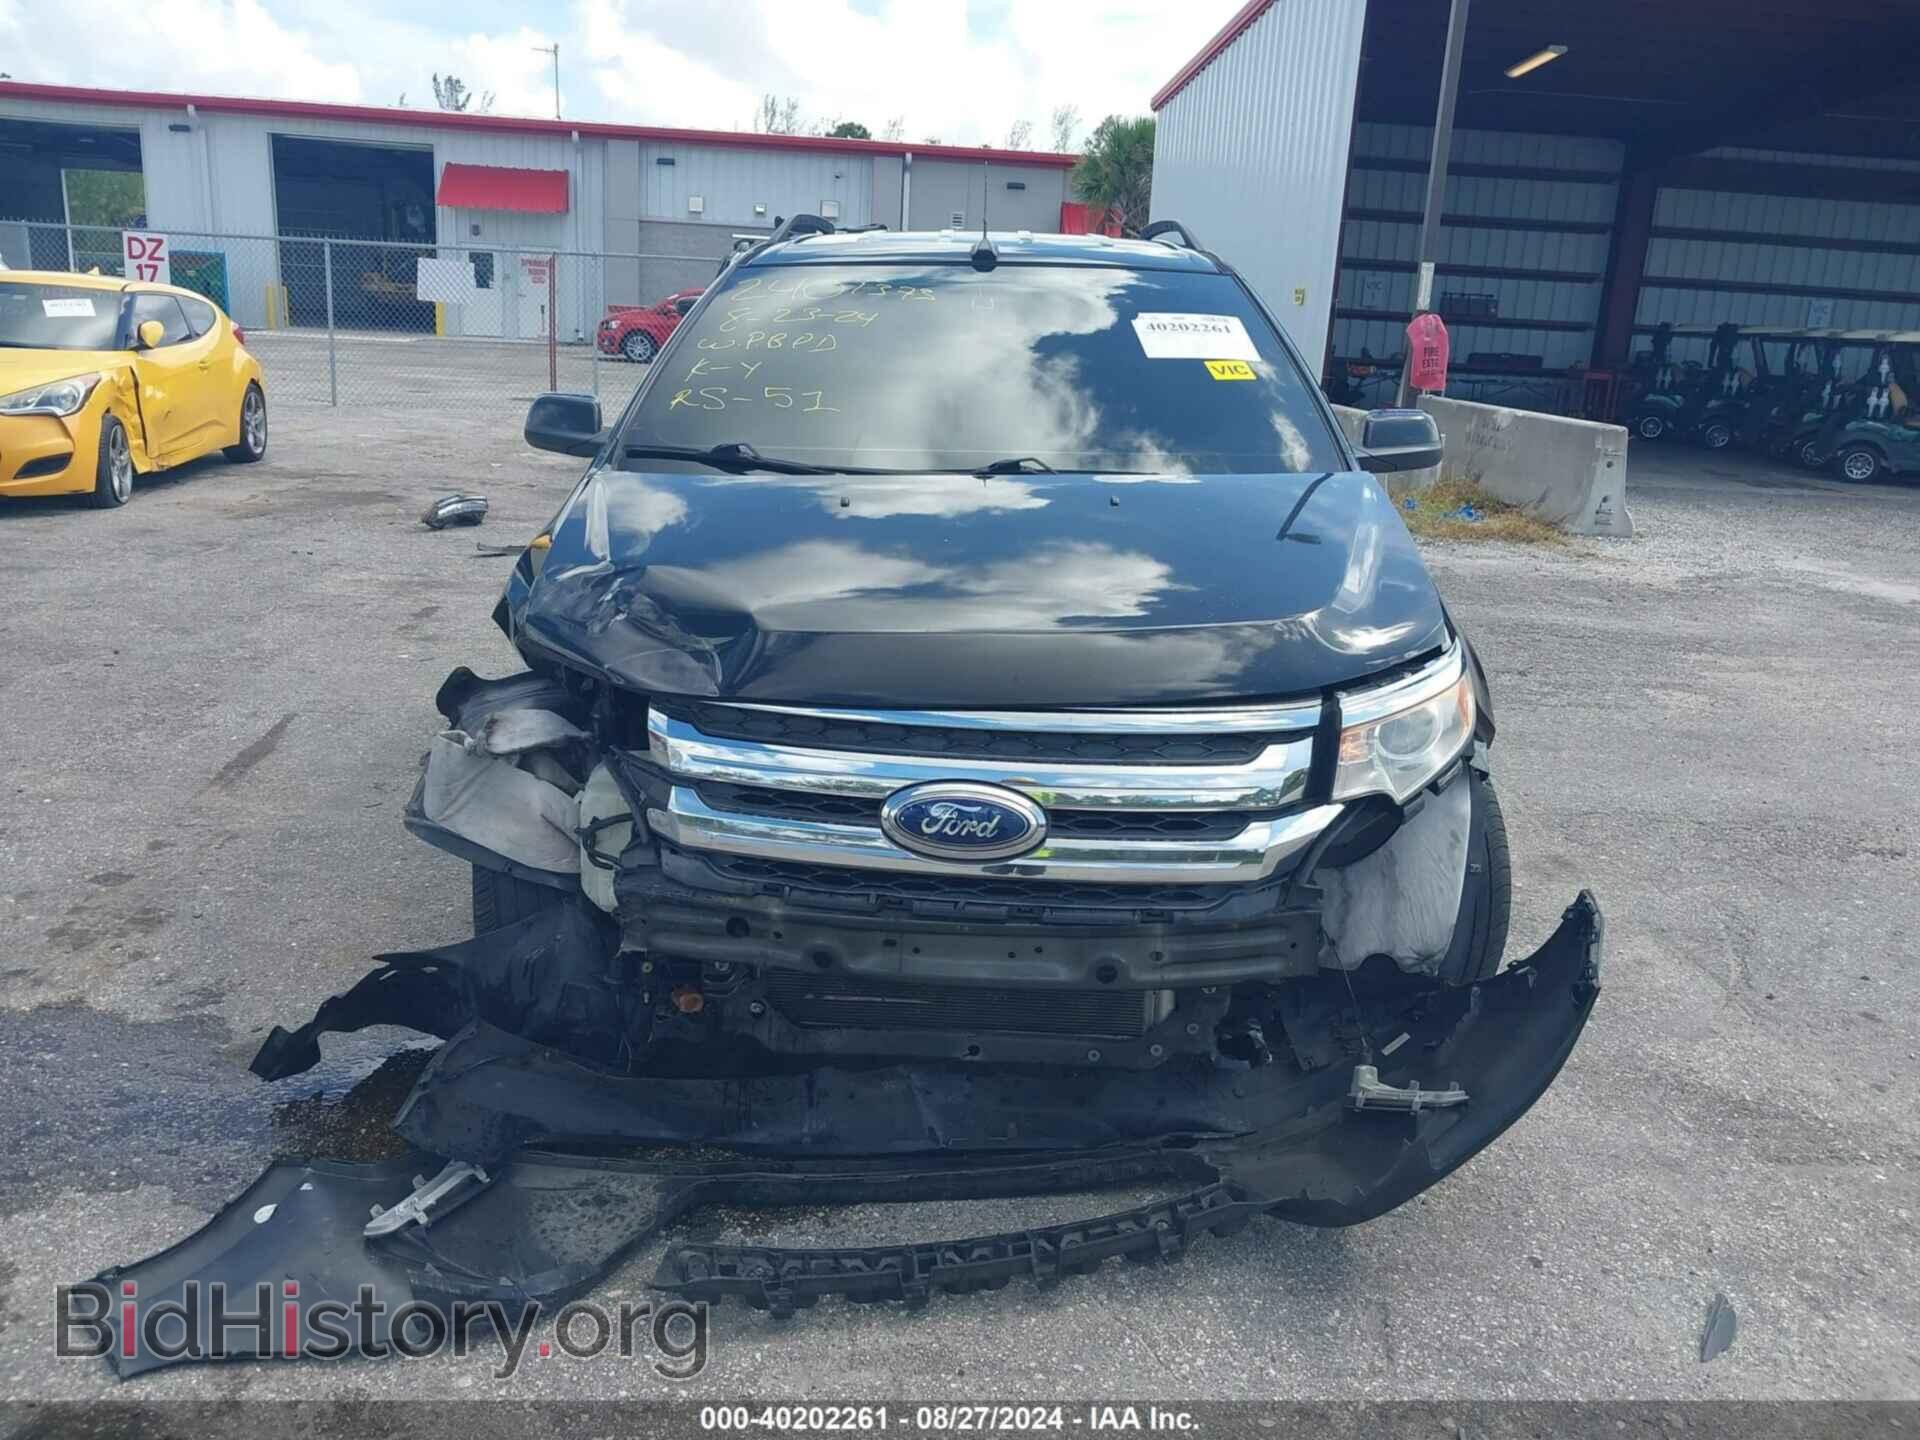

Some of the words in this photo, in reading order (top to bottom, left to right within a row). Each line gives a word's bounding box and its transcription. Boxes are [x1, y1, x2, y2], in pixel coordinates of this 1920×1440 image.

[127, 236, 165, 262] DZ
[136, 263, 159, 282] 17
[1146, 321, 1232, 335] 40202261
[1210, 364, 1249, 376] VIC
[921, 801, 1001, 838] Ford
